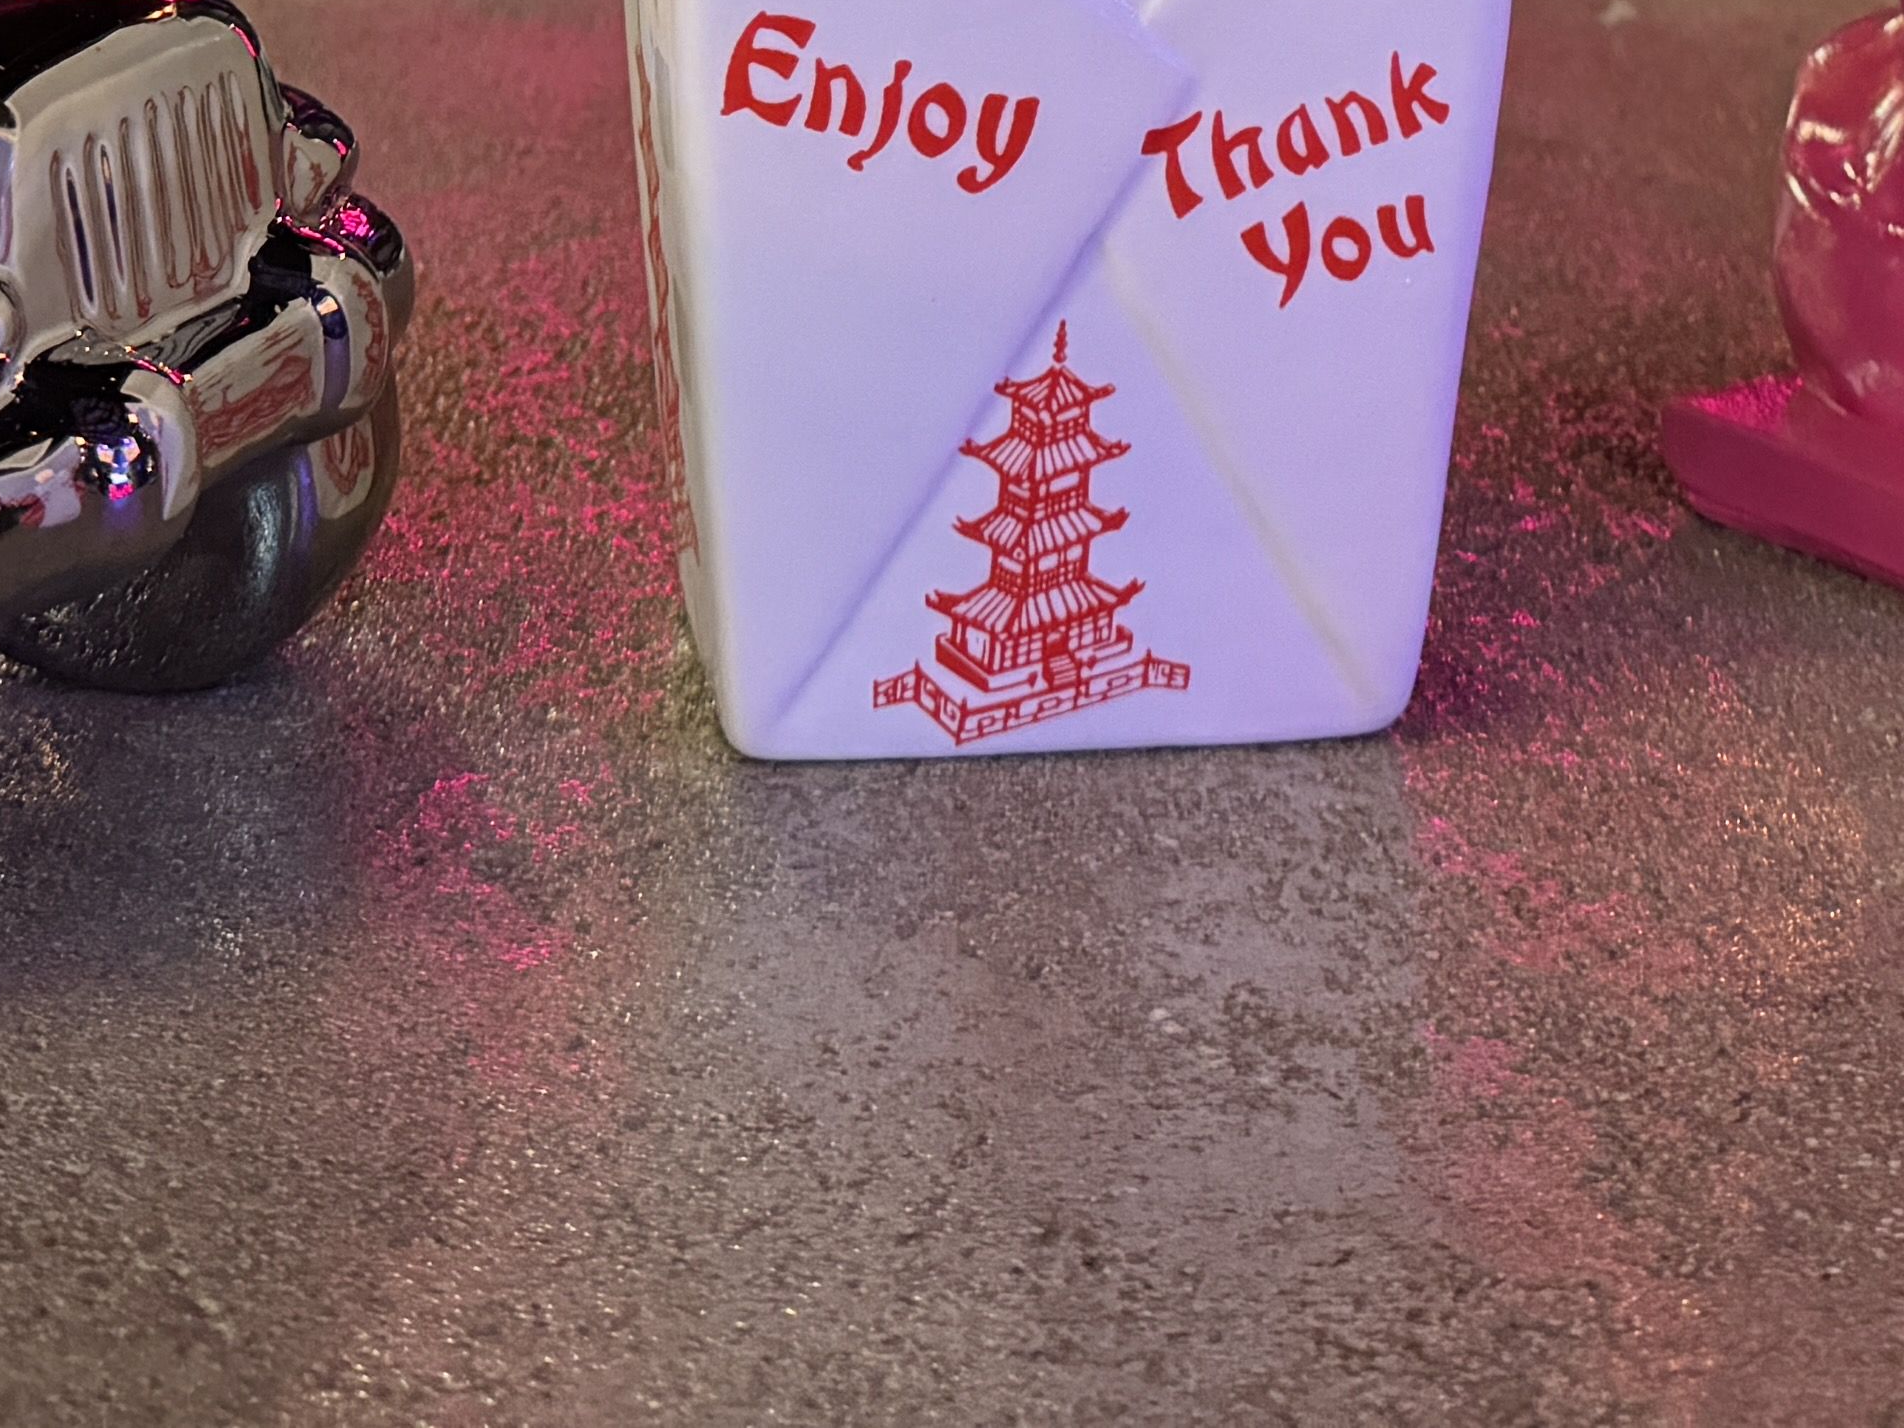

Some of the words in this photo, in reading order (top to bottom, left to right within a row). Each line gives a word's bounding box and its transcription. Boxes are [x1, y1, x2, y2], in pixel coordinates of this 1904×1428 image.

[720, 10, 1041, 195] Enjoy
[1140, 50, 1452, 219] Thank
[1239, 194, 1436, 310] You
